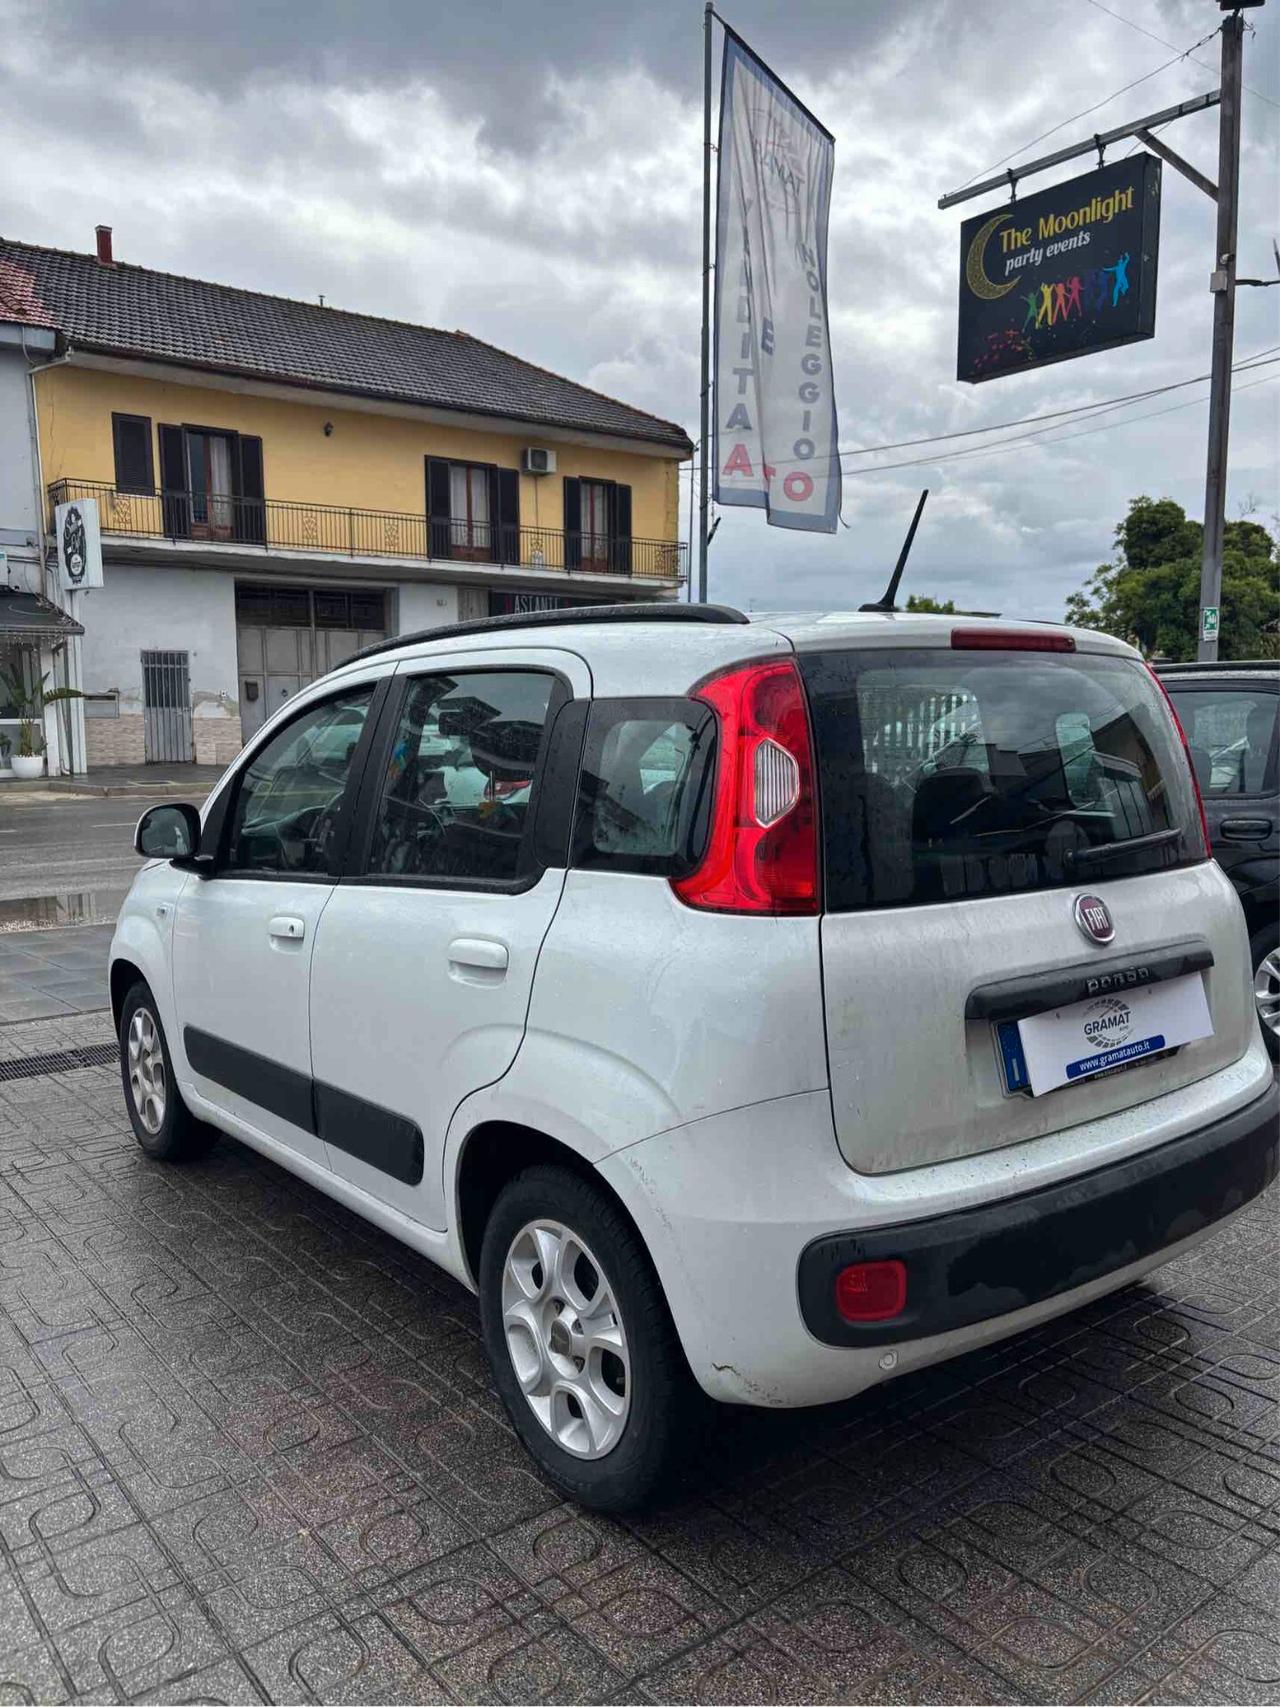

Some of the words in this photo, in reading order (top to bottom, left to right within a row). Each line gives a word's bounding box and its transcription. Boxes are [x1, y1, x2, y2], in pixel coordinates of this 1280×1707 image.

[1000, 227, 1032, 253] The
[1039, 185, 1135, 241] Moonlight
[1004, 247, 1043, 276] party
[1046, 230, 1092, 258] events
[793, 243, 823, 460] NOLEGGIO
[1085, 907, 1109, 930] FIAT
[1083, 1011, 1131, 1036] GRAMAT
[1079, 1040, 1151, 1072] www.gramatauto.it
